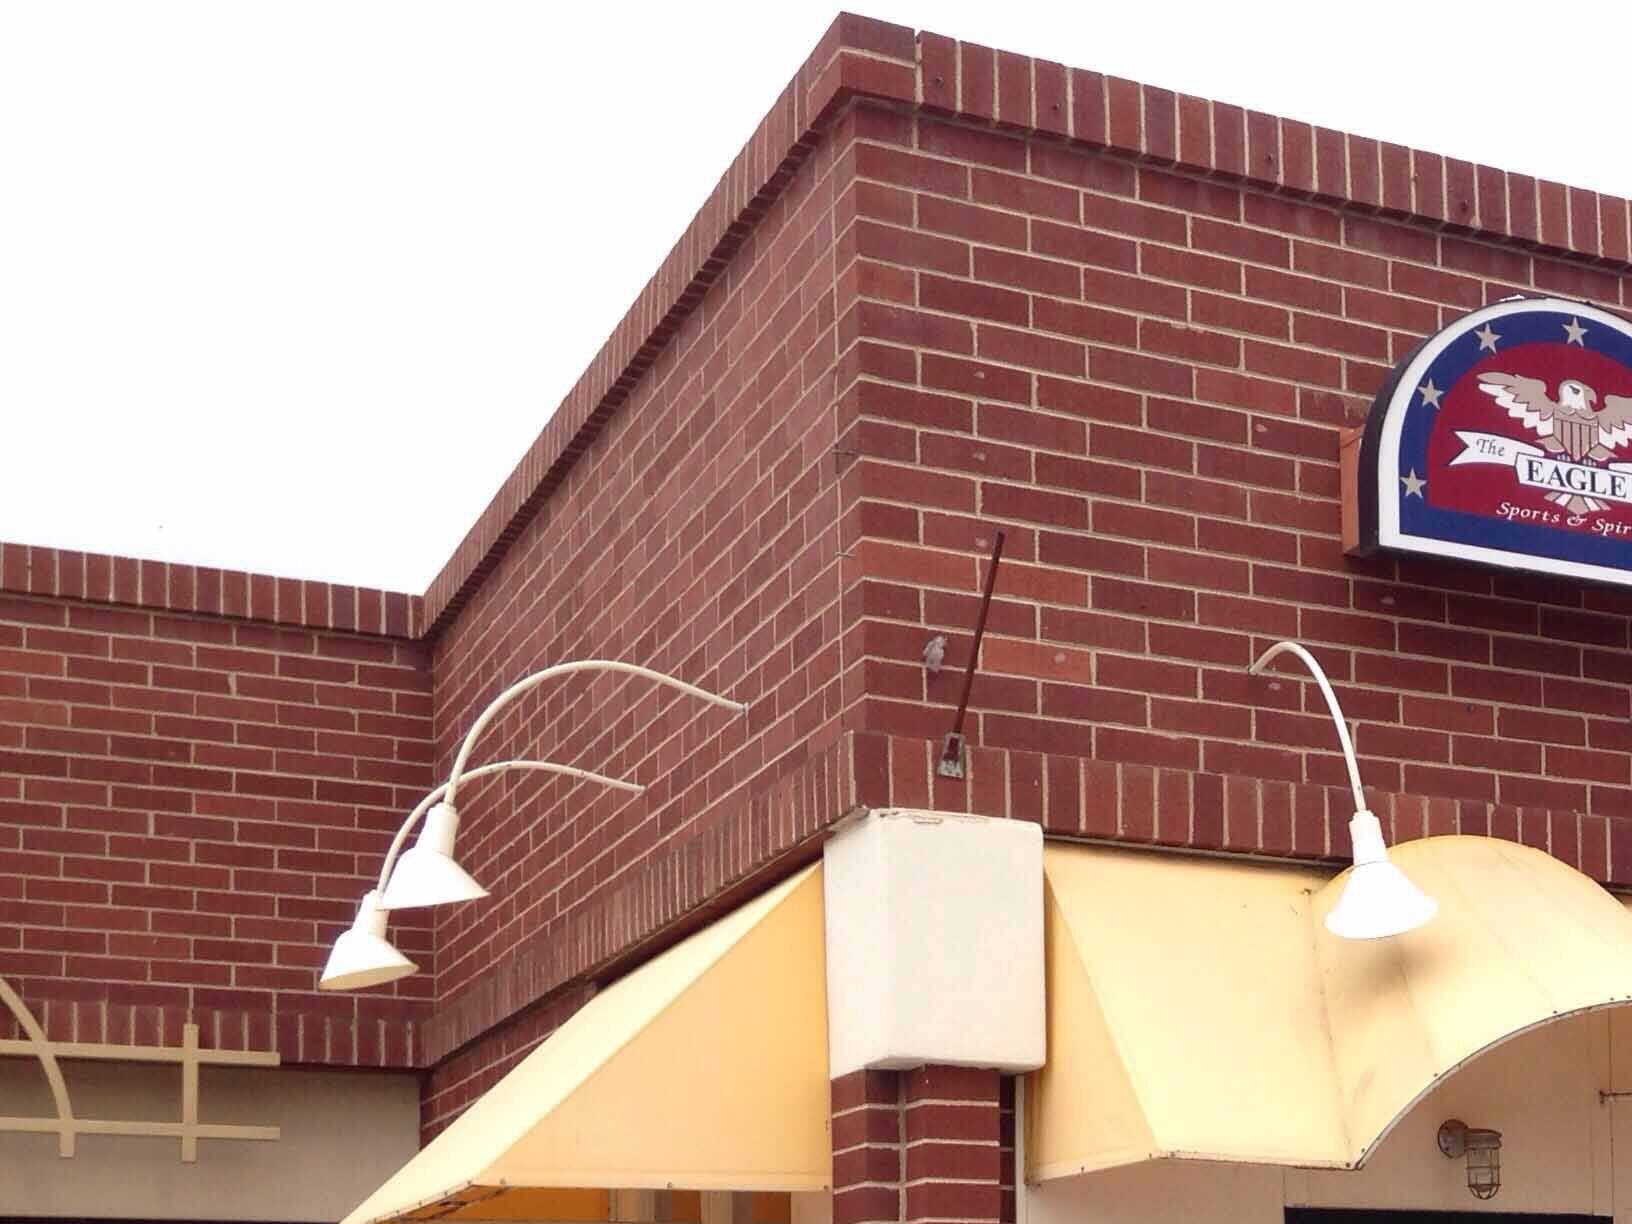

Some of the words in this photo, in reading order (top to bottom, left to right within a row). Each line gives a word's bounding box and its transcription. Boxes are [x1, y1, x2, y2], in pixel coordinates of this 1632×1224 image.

[1476, 437, 1505, 457] The
[1526, 458, 1627, 499] EAGLE
[1496, 501, 1560, 522] Sports
[1566, 513, 1588, 527] &
